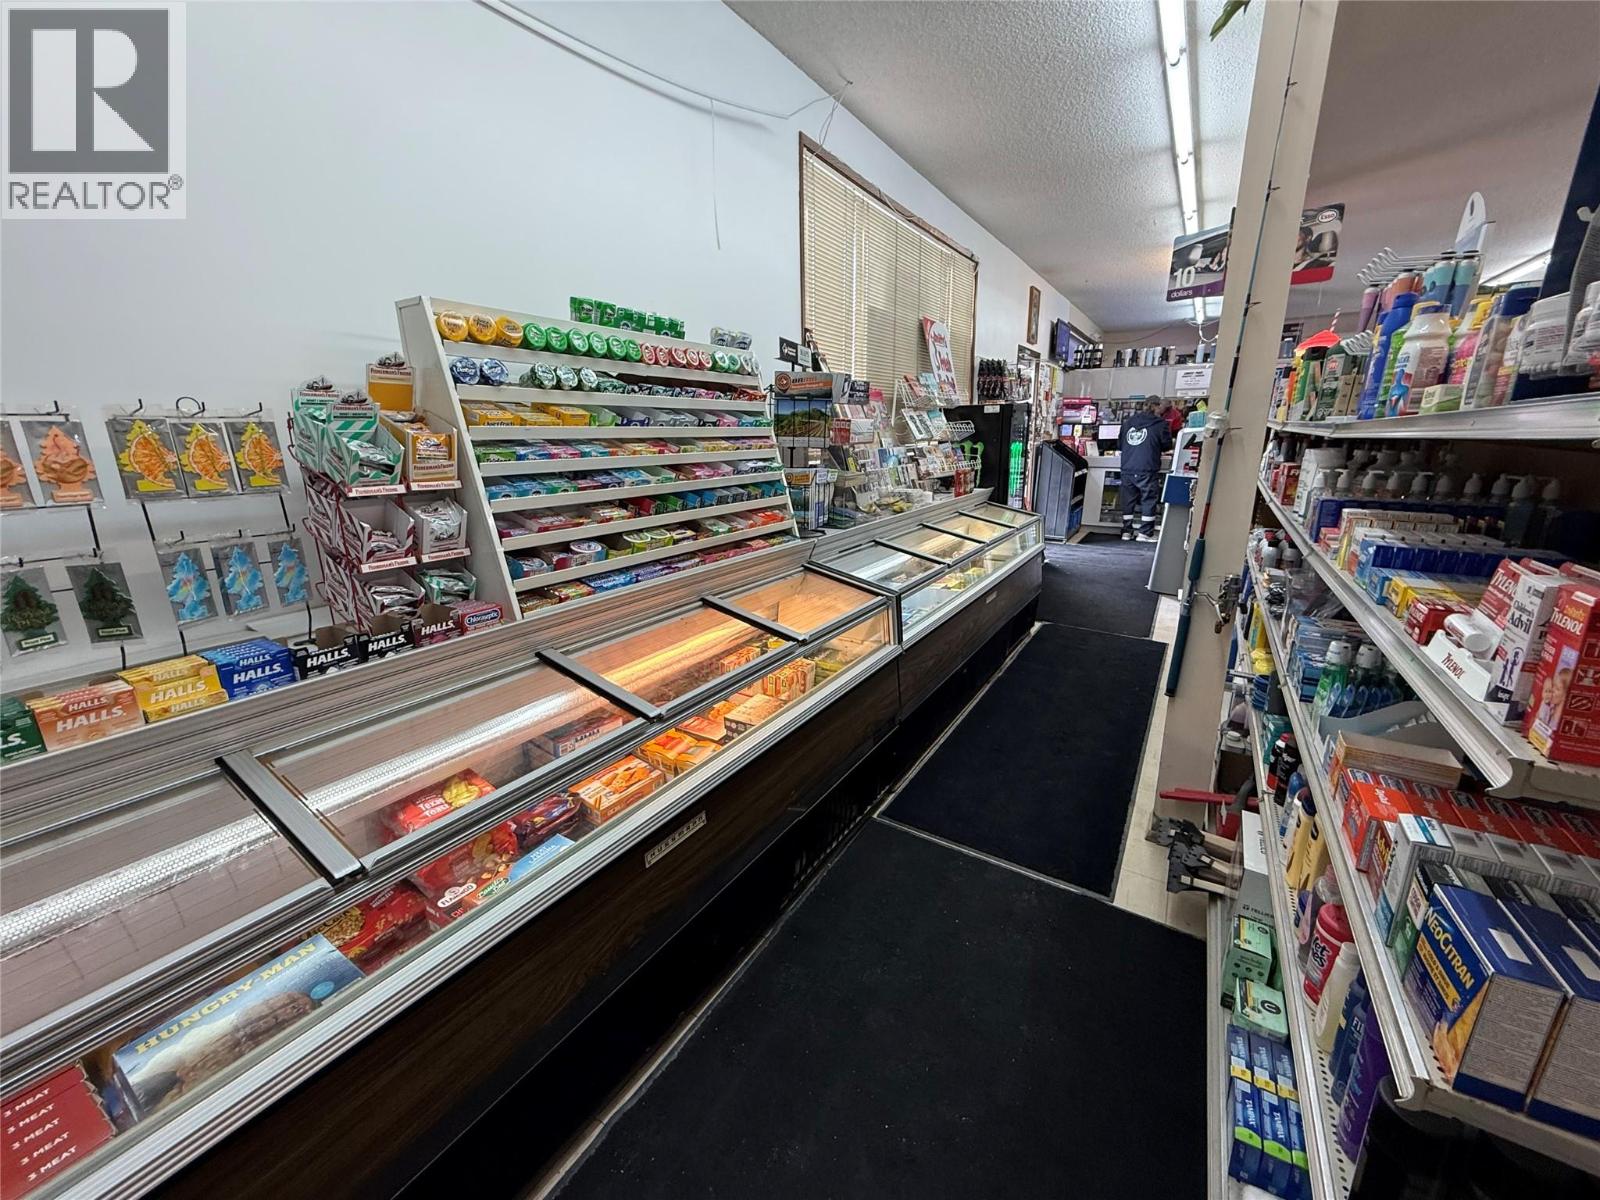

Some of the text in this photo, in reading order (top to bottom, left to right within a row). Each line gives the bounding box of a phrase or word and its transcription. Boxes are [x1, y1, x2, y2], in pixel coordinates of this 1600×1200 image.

[1174, 266, 1196, 288] 10
[1170, 289, 1193, 299] dollars
[421, 620, 455, 636] HALLS
[466, 611, 499, 624] Chloraseptic
[1508, 611, 1532, 635] Advil
[1550, 607, 1584, 636] TYLENOL
[369, 635, 406, 652] HALLS
[239, 654, 272, 666] HALLS
[307, 648, 350, 668] HALLS
[1441, 652, 1466, 680] TYLENOL
[233, 663, 284, 684] HALLS
[150, 680, 208, 703] HALLS
[68, 695, 107, 712] HALLS
[171, 698, 206, 713] HALLS
[56, 706, 127, 733] HALLS
[137, 943, 317, 1055] HUNGRY MAN
[14, 1088, 50, 1113] MEAT
[18, 1103, 55, 1130] MEAT
[23, 1117, 60, 1144] MEAT
[32, 1131, 69, 1157] MEAT
[40, 1146, 77, 1173] MEAT
